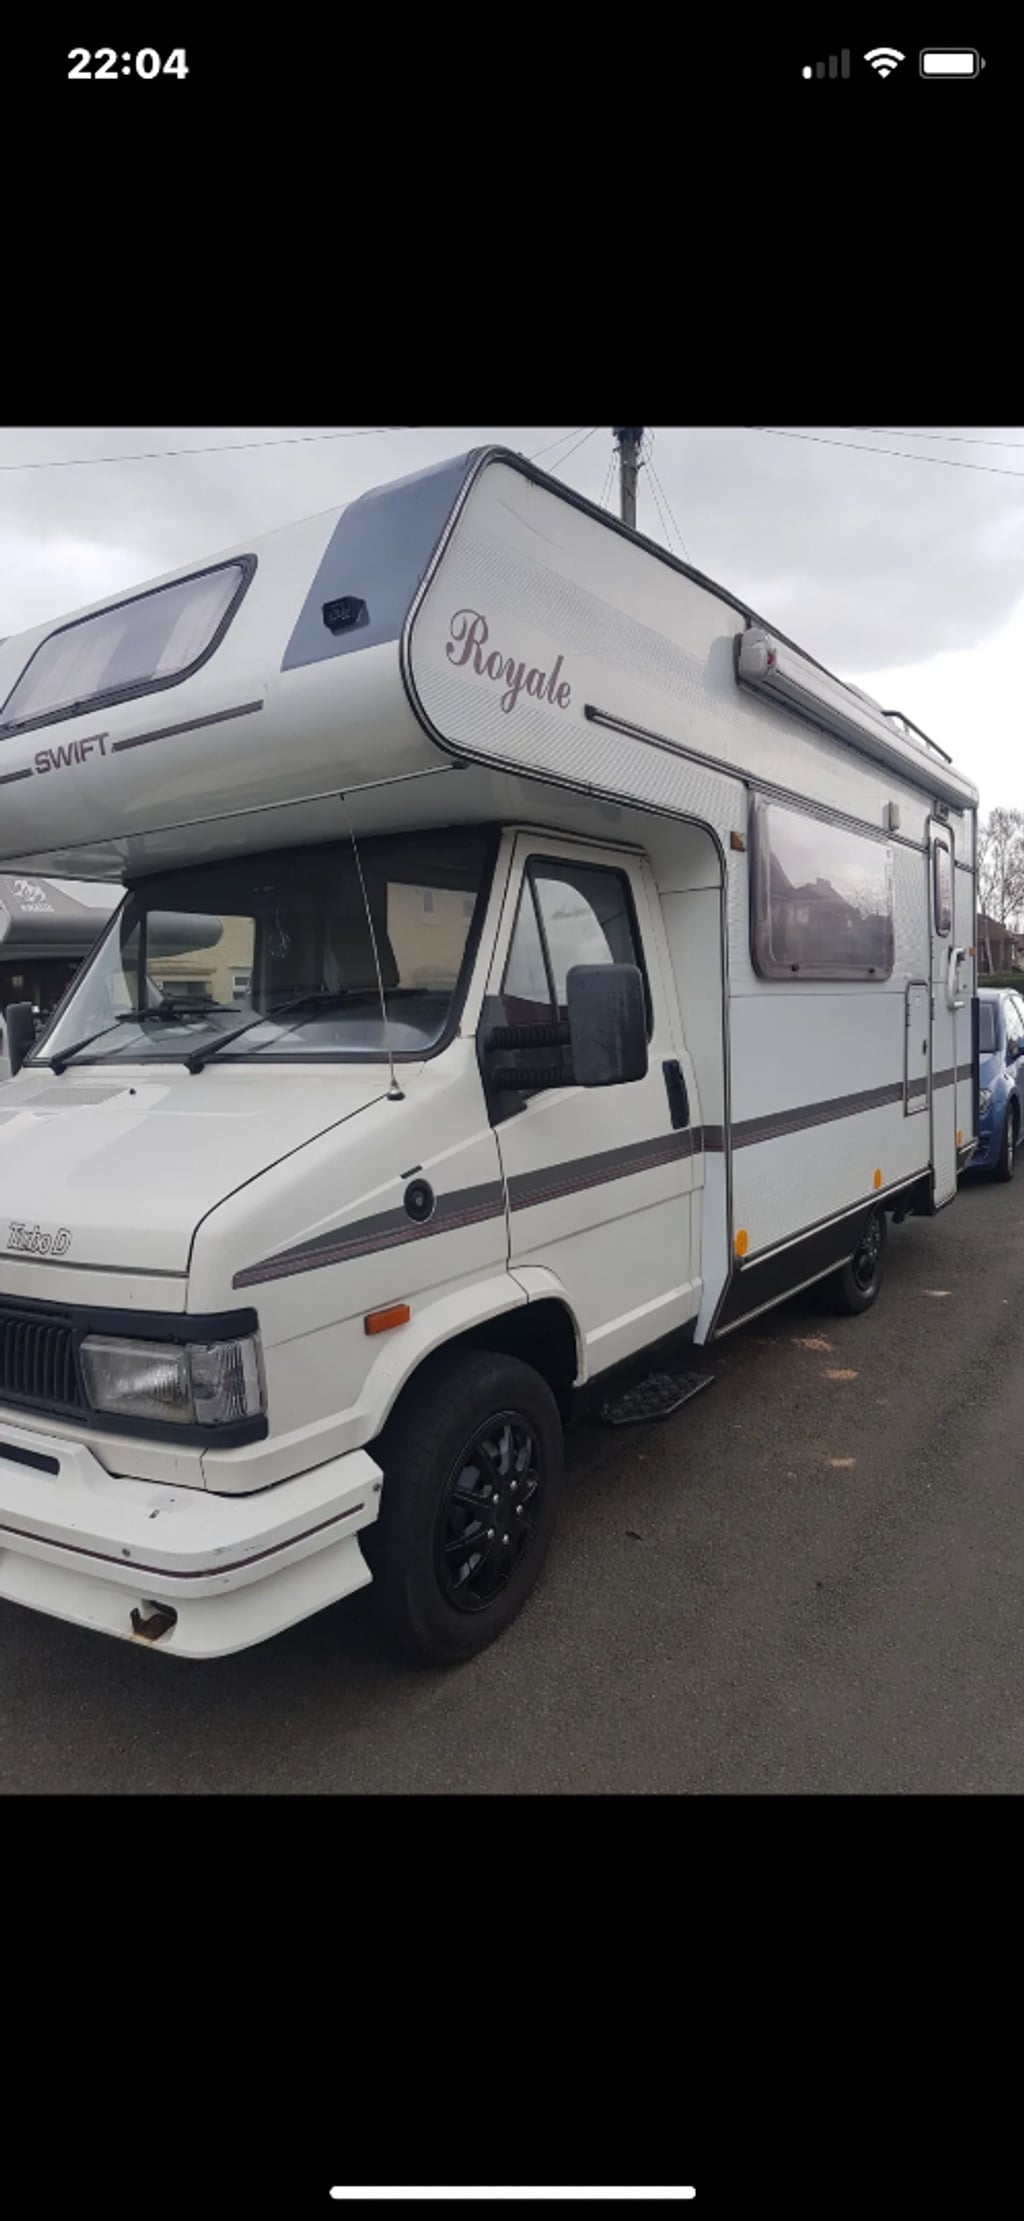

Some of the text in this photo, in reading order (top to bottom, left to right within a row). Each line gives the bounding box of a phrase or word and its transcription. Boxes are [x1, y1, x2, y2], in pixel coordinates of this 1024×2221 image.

[445, 608, 571, 713] Royale
[34, 732, 109, 774] SWIFT
[6, 1222, 73, 1255] Turbo D
